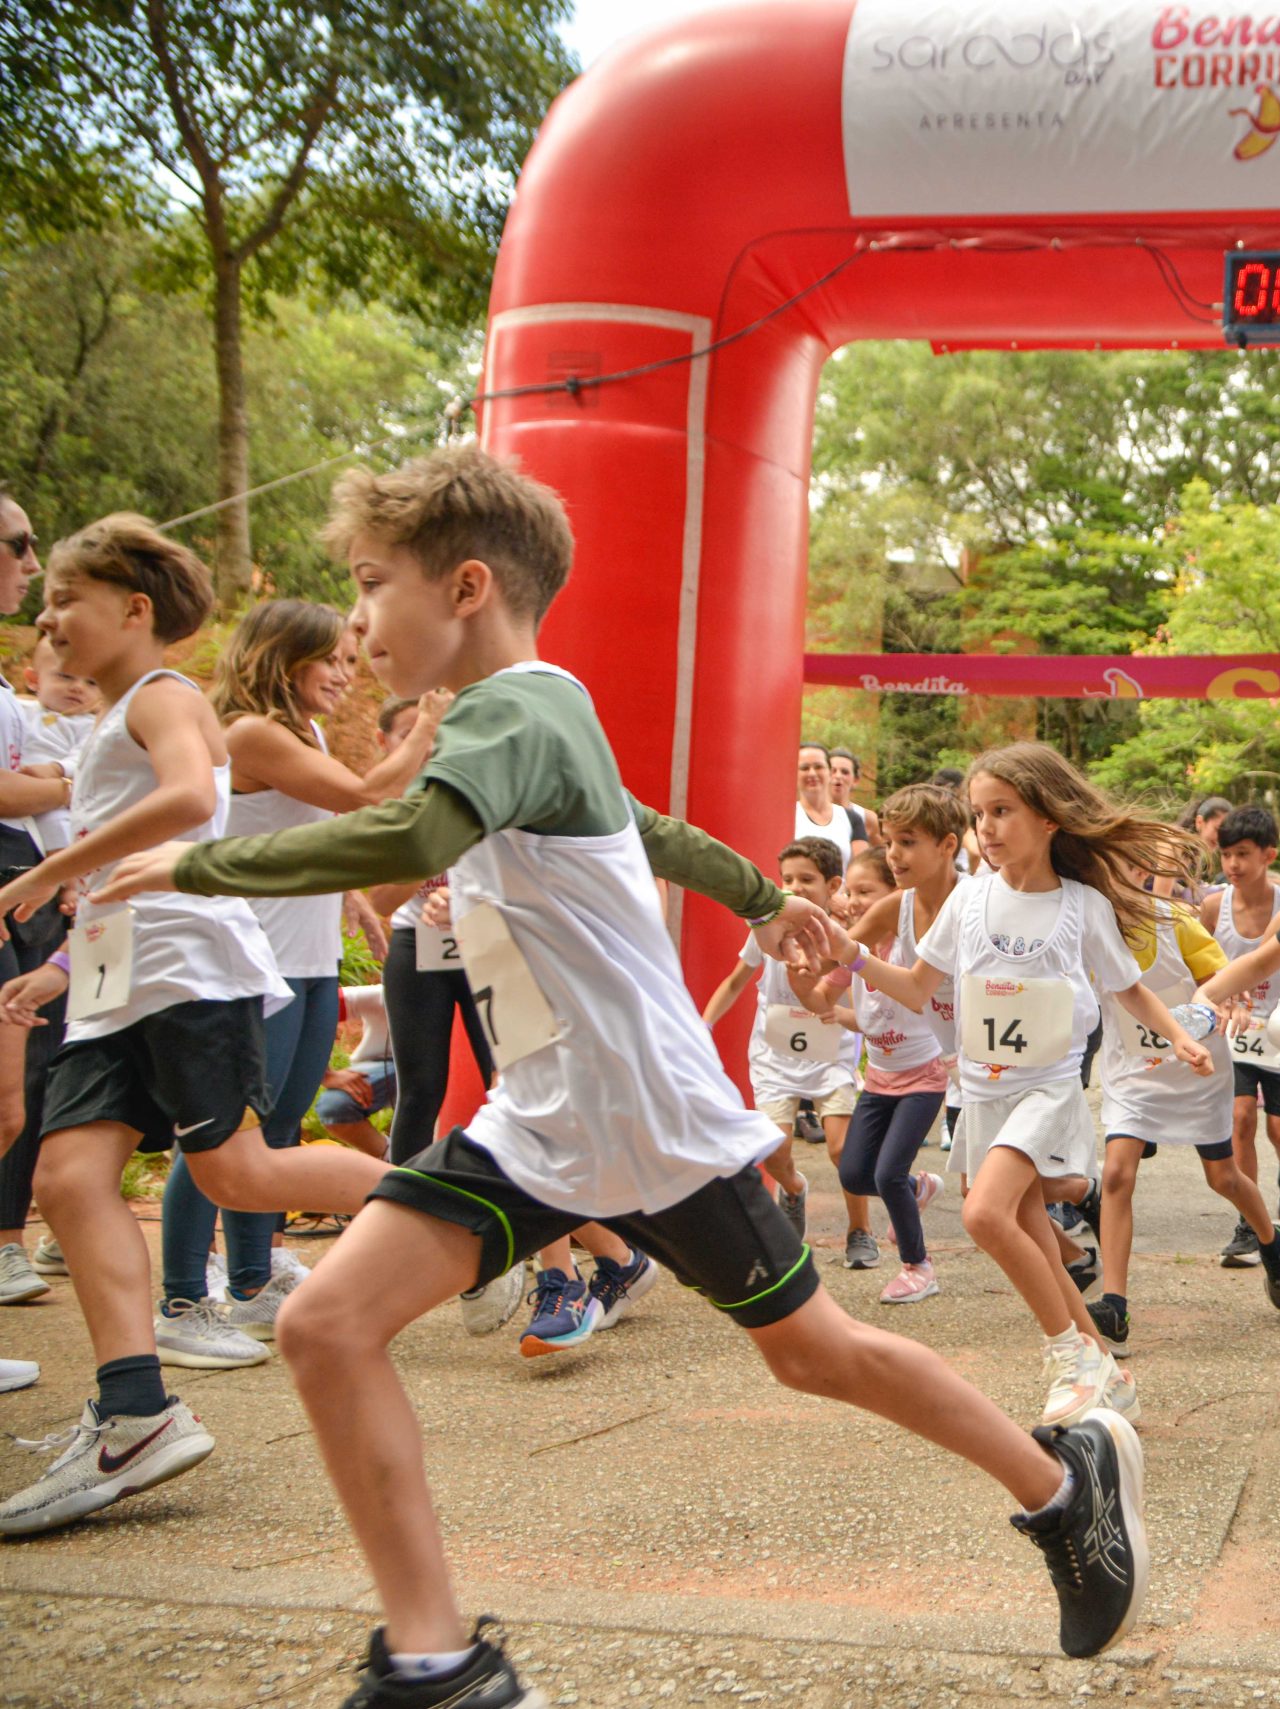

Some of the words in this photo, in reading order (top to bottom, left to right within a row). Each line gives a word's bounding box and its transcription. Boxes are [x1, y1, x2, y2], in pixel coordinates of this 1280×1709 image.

[919, 111, 1065, 129] APRESENTA
[860, 674, 969, 694] Bendita
[790, 1032, 808, 1052] 6
[983, 1018, 1027, 1053] 14
[1234, 1036, 1264, 1056] 54
